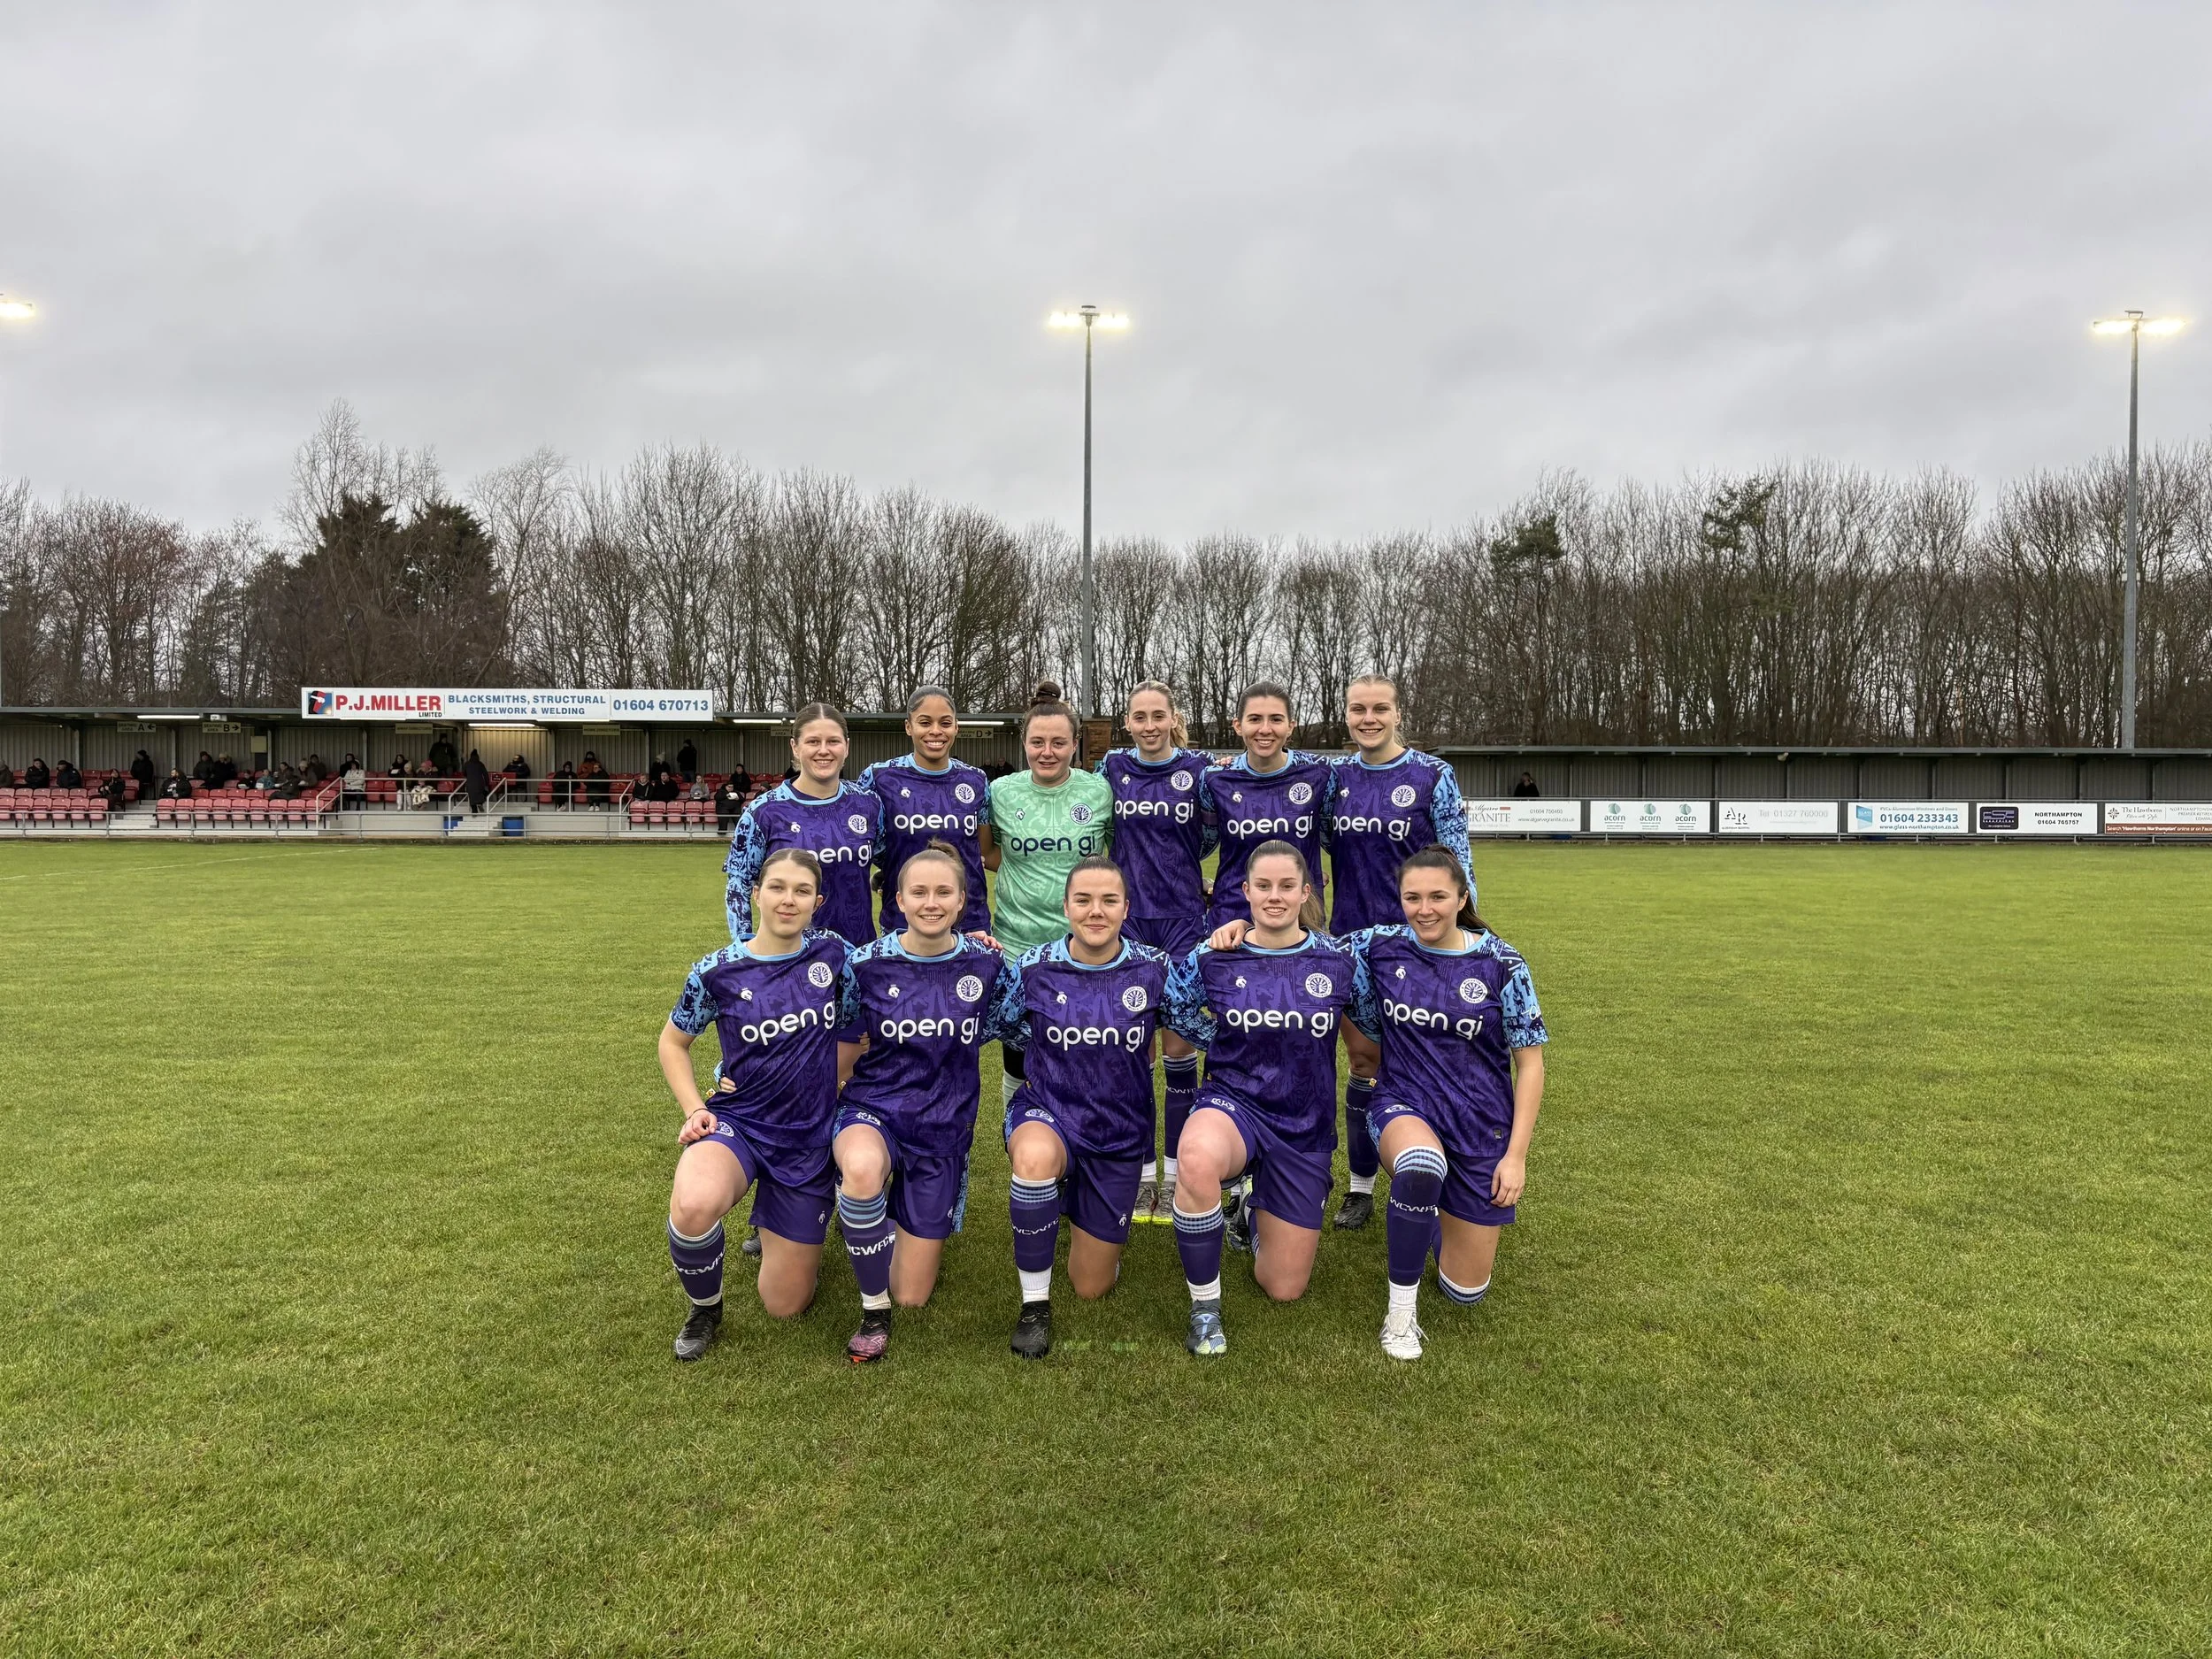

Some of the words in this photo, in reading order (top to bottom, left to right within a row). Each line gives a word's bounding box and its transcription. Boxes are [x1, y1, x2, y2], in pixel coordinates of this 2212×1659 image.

[335, 695, 442, 711] P.J.MILLER
[448, 695, 531, 705] BLACKSMITHS,
[533, 695, 607, 704] STRUCTURAL
[613, 699, 655, 711] 01604
[658, 700, 709, 711] 670713
[138, 723, 145, 732] A
[224, 724, 230, 733] B
[894, 814, 959, 835] open
[964, 811, 978, 836] gi
[1115, 800, 1169, 820] open
[1175, 799, 1194, 824] gi
[1880, 813, 1915, 823] 01604
[1917, 813, 1959, 823] 233343
[1227, 818, 1289, 841] open
[1294, 810, 1314, 839] gi
[1333, 815, 1382, 836] open
[1388, 817, 1411, 841] gi
[858, 840, 872, 868] gi
[1010, 837, 1072, 856] open
[1079, 832, 1095, 857] gi
[741, 1008, 818, 1046] open
[823, 995, 835, 1030] gi
[880, 1018, 955, 1044] open
[960, 1012, 980, 1045] gi
[1225, 1009, 1303, 1033] open
[1310, 1007, 1334, 1038] gi
[1384, 998, 1448, 1030] open
[1455, 1015, 1484, 1040] gi
[1047, 1025, 1119, 1051] open
[1125, 1020, 1145, 1053] gi
